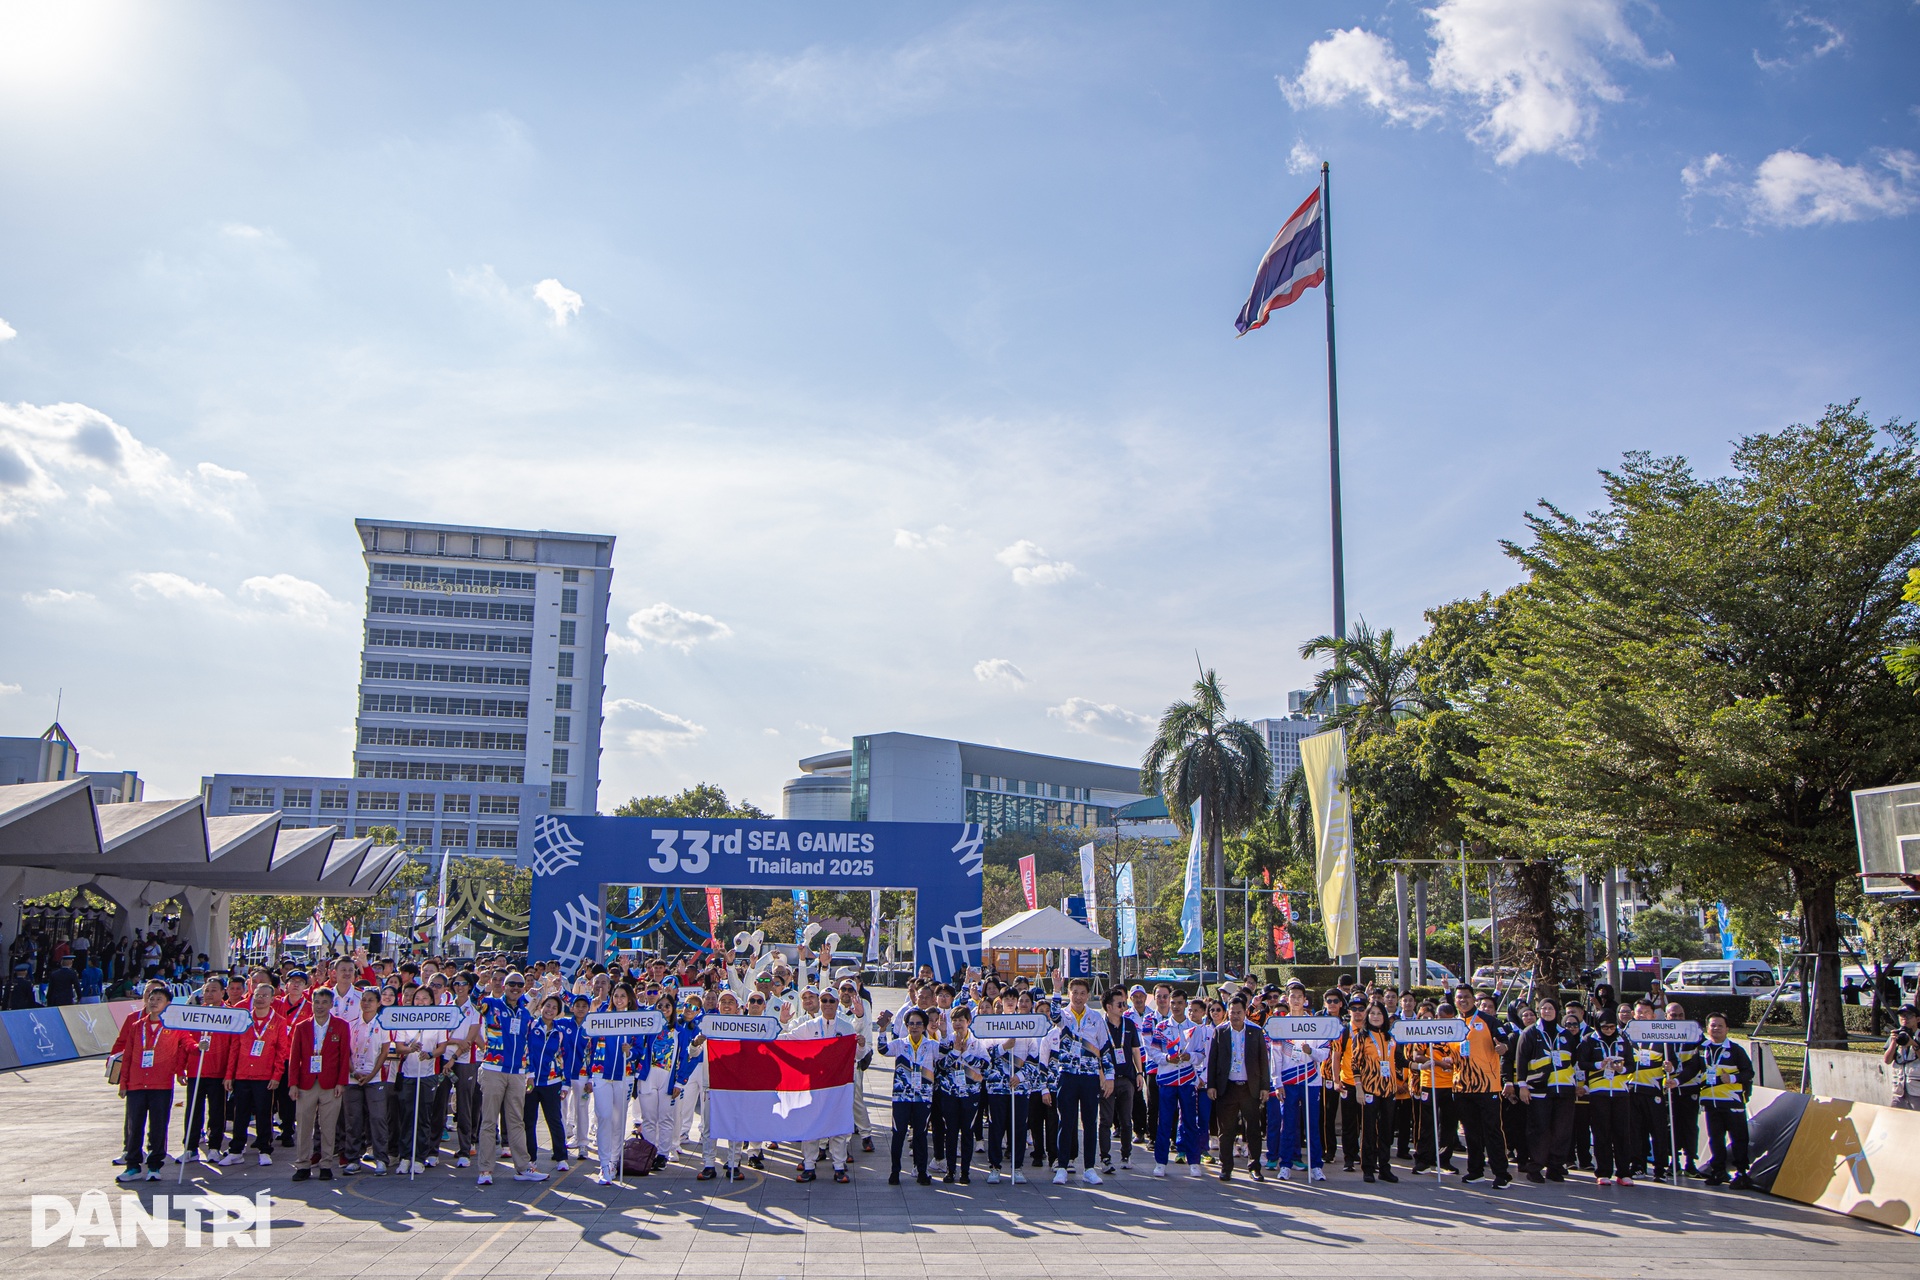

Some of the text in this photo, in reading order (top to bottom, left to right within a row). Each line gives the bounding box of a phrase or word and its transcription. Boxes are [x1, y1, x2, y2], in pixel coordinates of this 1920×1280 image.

[648, 829, 875, 874] 33rd SEA GAMES
[747, 856, 874, 876] Thailand 2025
[182, 1011, 232, 1025] VIETNAM
[391, 1012, 451, 1022] SINGAPORE
[591, 1017, 654, 1029] PHILIPPINES
[711, 1021, 767, 1033] INDONESIA
[986, 1020, 1036, 1031] THAILAND
[1291, 1023, 1317, 1033] LAOS
[1651, 1022, 1676, 1030] BRUNEI
[1405, 1026, 1454, 1036] MALAYSIA
[1641, 1032, 1687, 1040] DARUSSALAM
